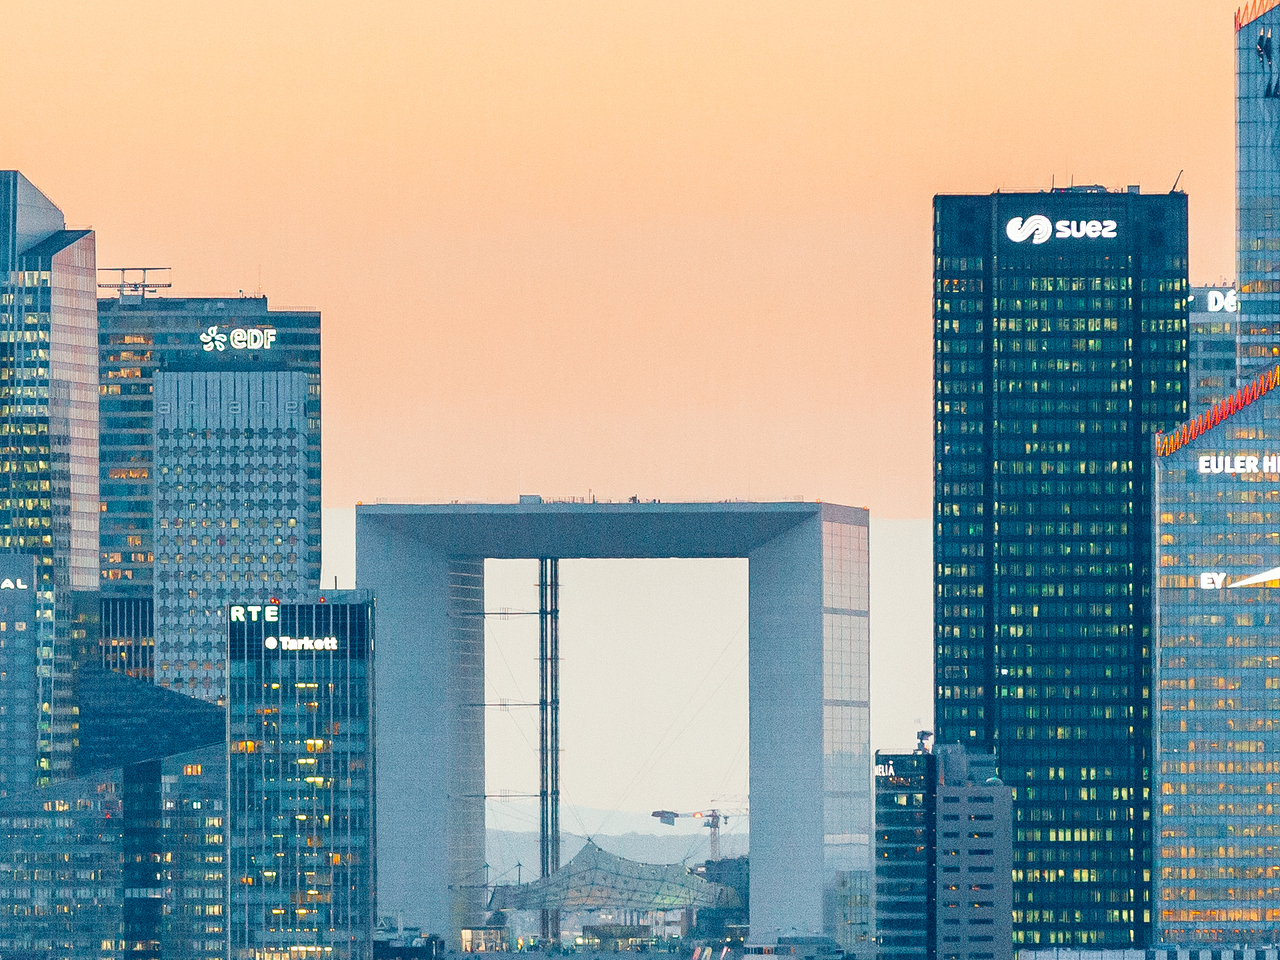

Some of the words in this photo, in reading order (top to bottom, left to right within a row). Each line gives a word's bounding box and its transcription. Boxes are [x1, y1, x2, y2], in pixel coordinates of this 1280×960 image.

[1198, 455, 1259, 473] EULER
[1200, 572, 1227, 590] EY
[230, 605, 279, 622] RTE
[278, 636, 338, 650] Tarkett
